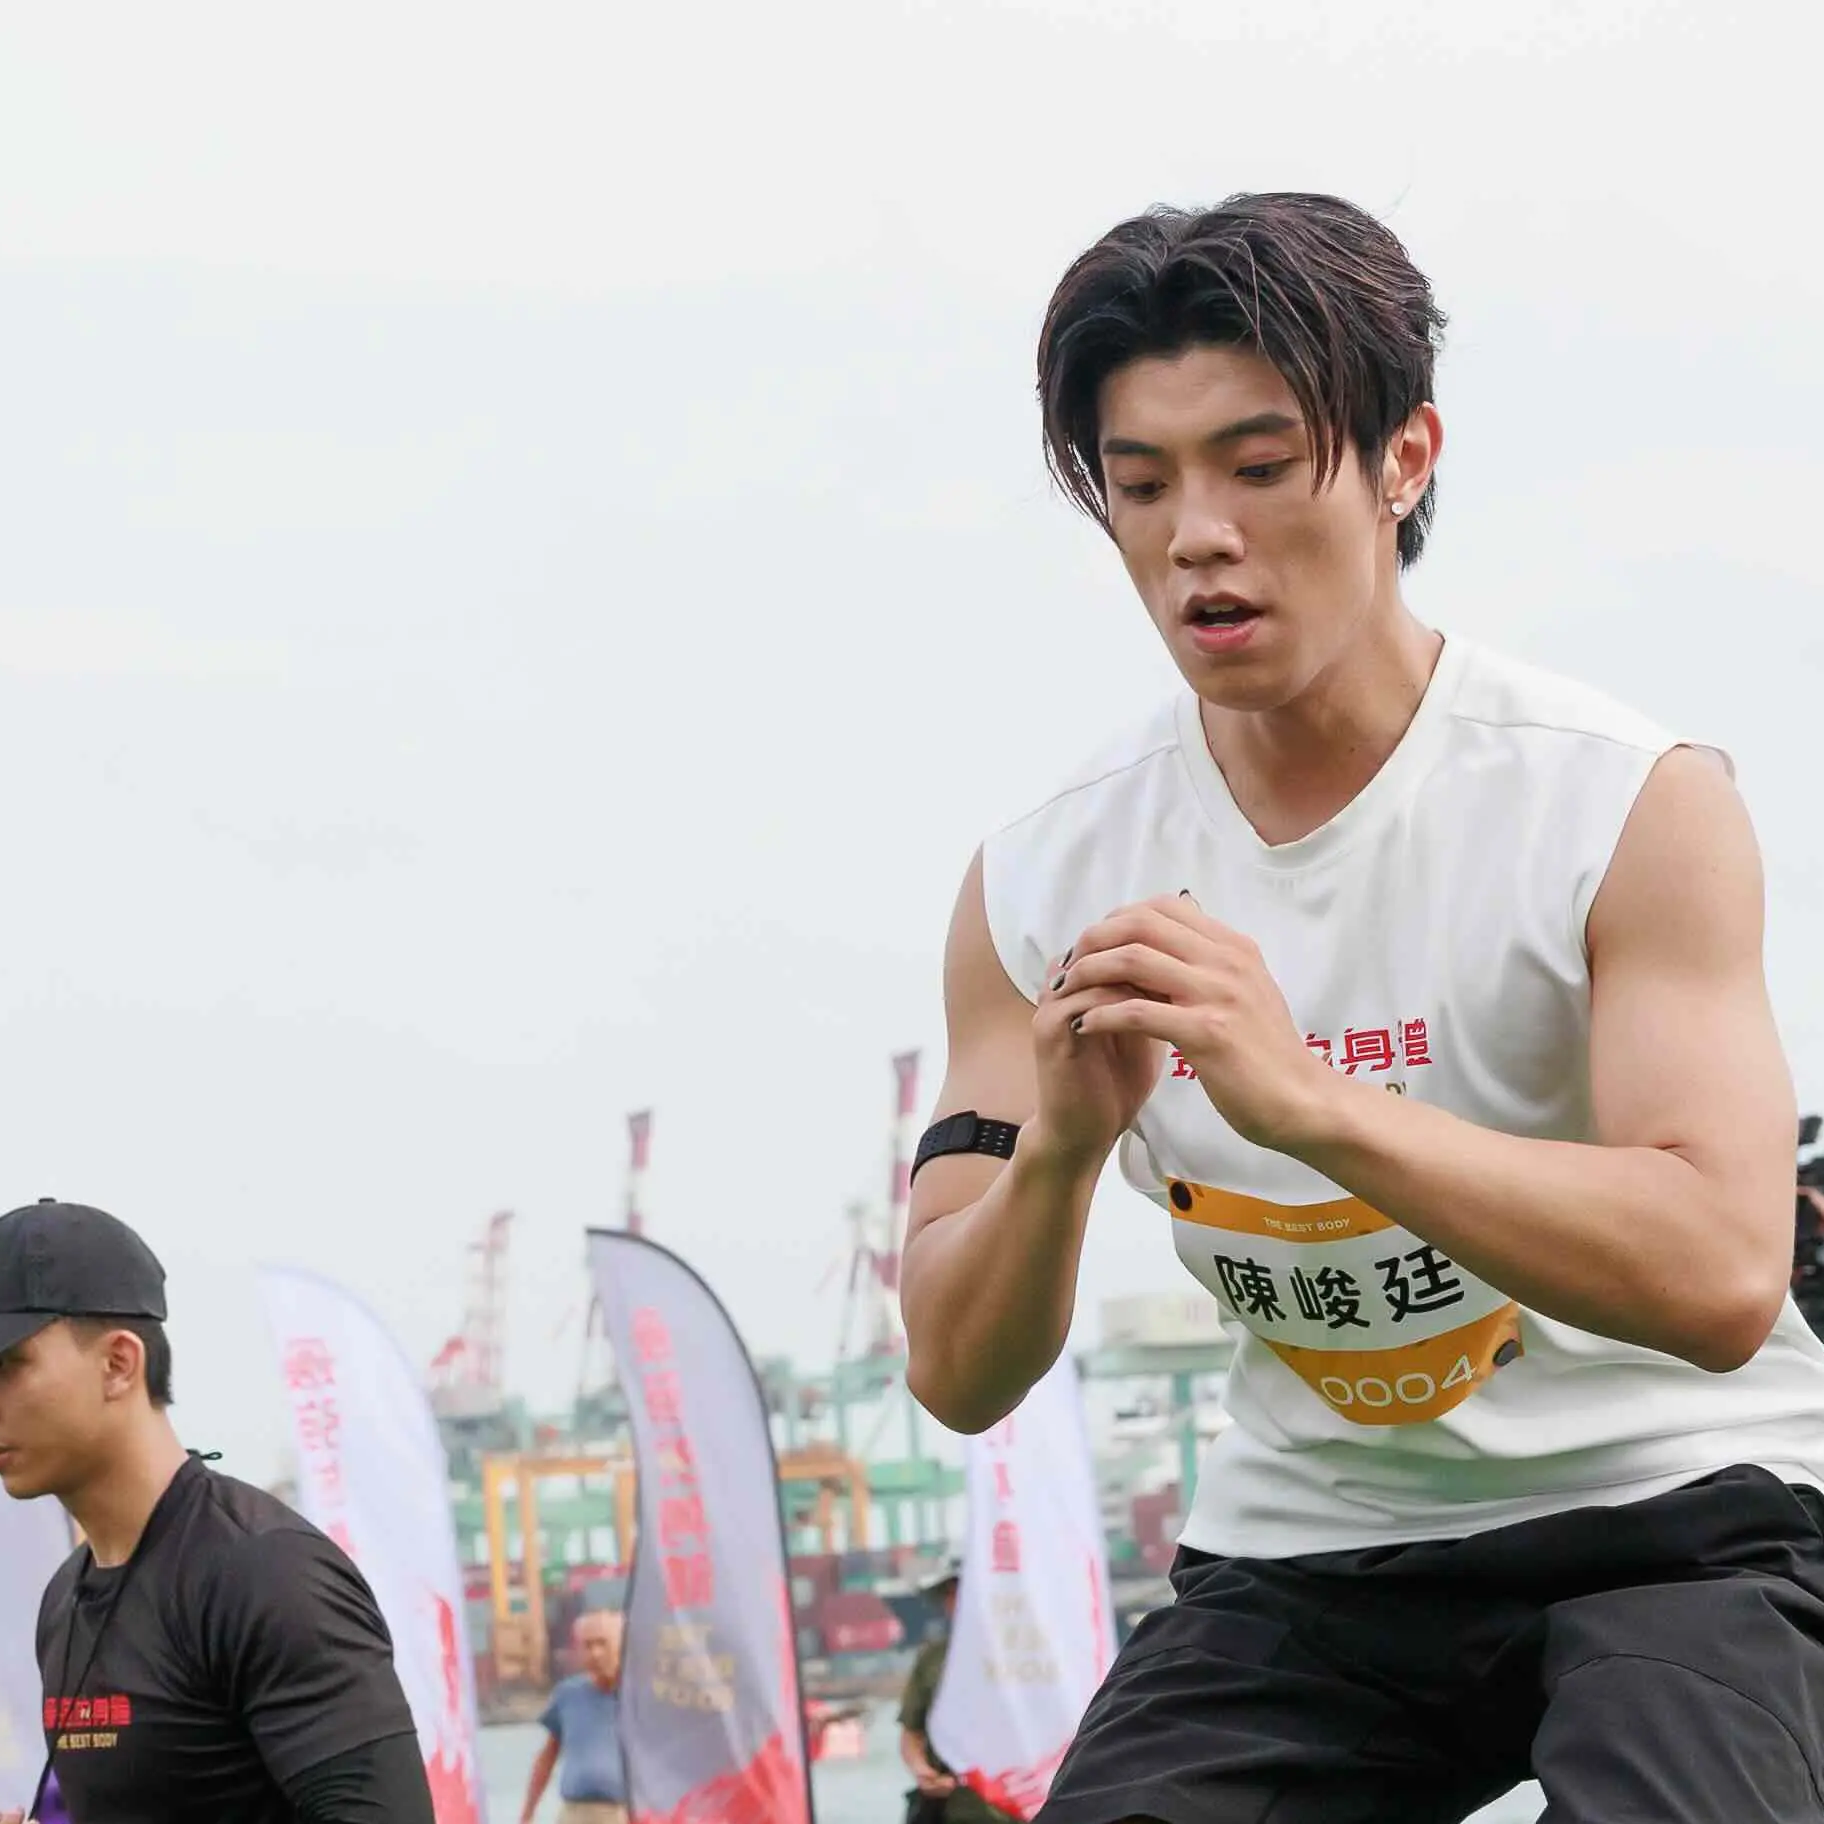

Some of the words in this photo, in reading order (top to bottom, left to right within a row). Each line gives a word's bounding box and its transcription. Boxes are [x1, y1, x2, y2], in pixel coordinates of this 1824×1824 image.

[1316, 1216, 1351, 1232] BODY
[1213, 1246, 1465, 1330] 陳峻廷
[1320, 1353, 1477, 1408] 0004
